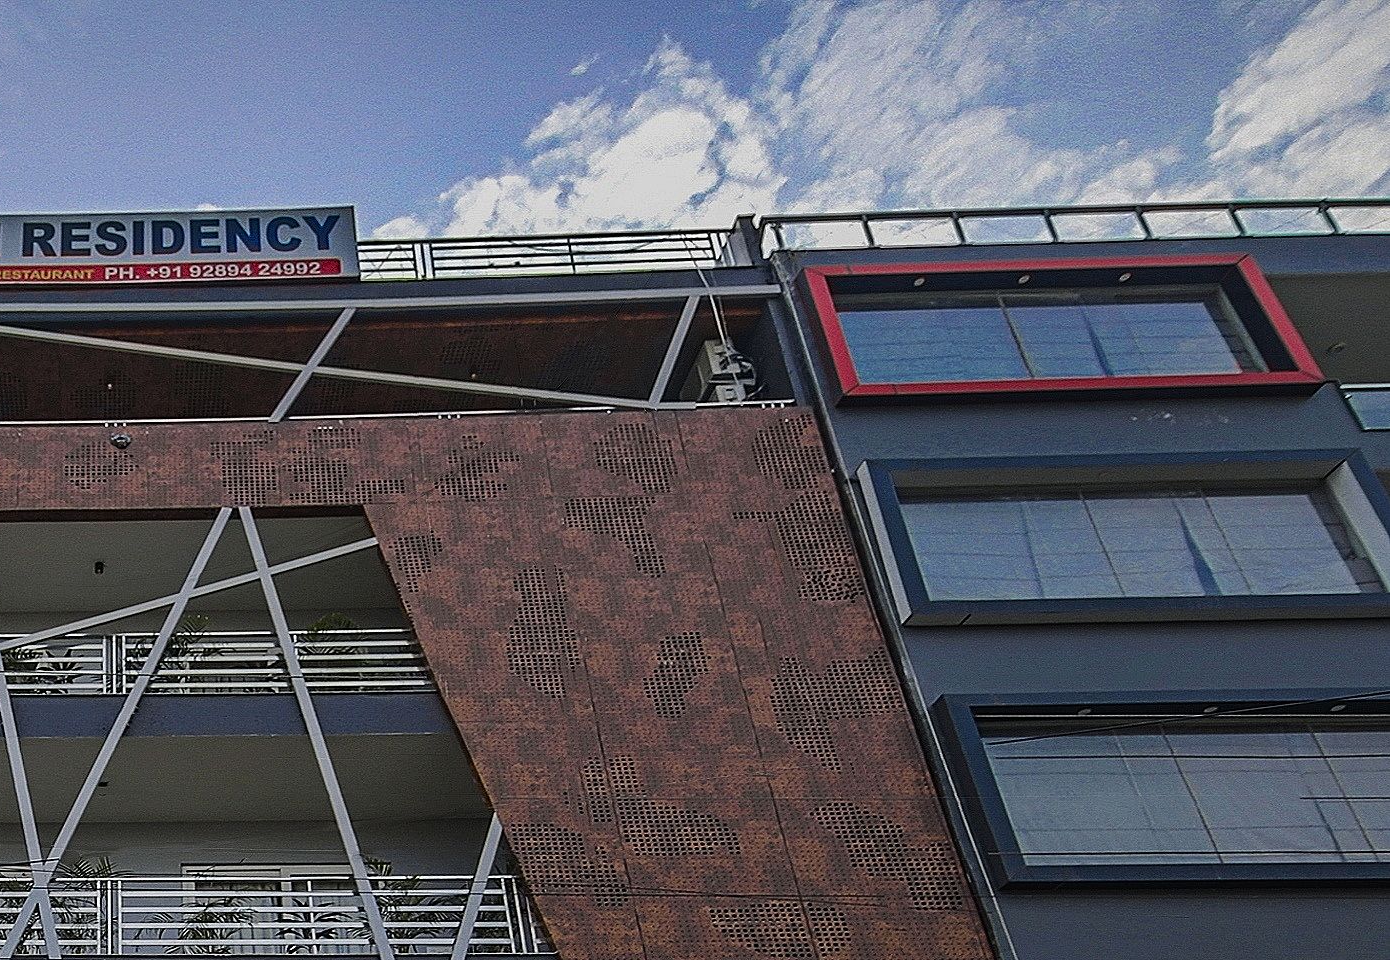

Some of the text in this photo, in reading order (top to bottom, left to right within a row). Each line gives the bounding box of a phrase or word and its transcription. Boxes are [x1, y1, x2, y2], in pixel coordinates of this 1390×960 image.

[21, 214, 340, 258] RESIDENCY
[104, 266, 140, 280] PH.
[146, 265, 181, 279] +91
[189, 263, 253, 278] 92894
[258, 261, 321, 276] 24992
